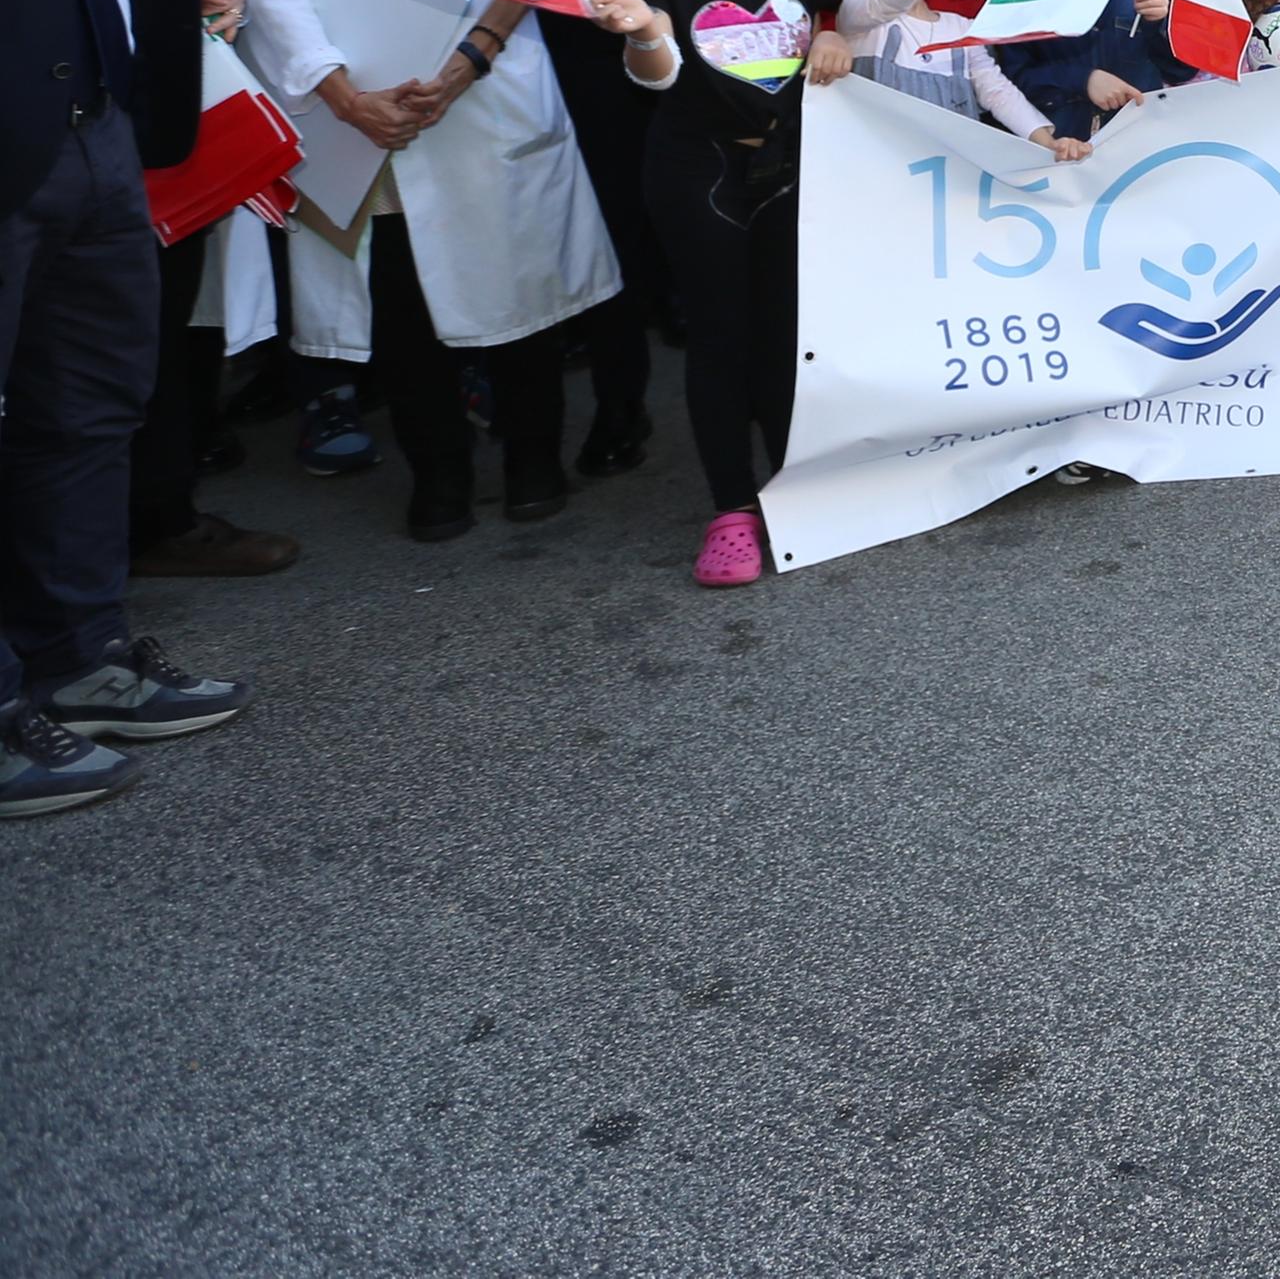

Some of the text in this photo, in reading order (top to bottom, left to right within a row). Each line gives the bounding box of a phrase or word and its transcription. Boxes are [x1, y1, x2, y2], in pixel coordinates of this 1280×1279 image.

[936, 312, 1062, 350] 1869
[944, 350, 1069, 391] 2019
[1098, 398, 1265, 428] EDIATRICO
